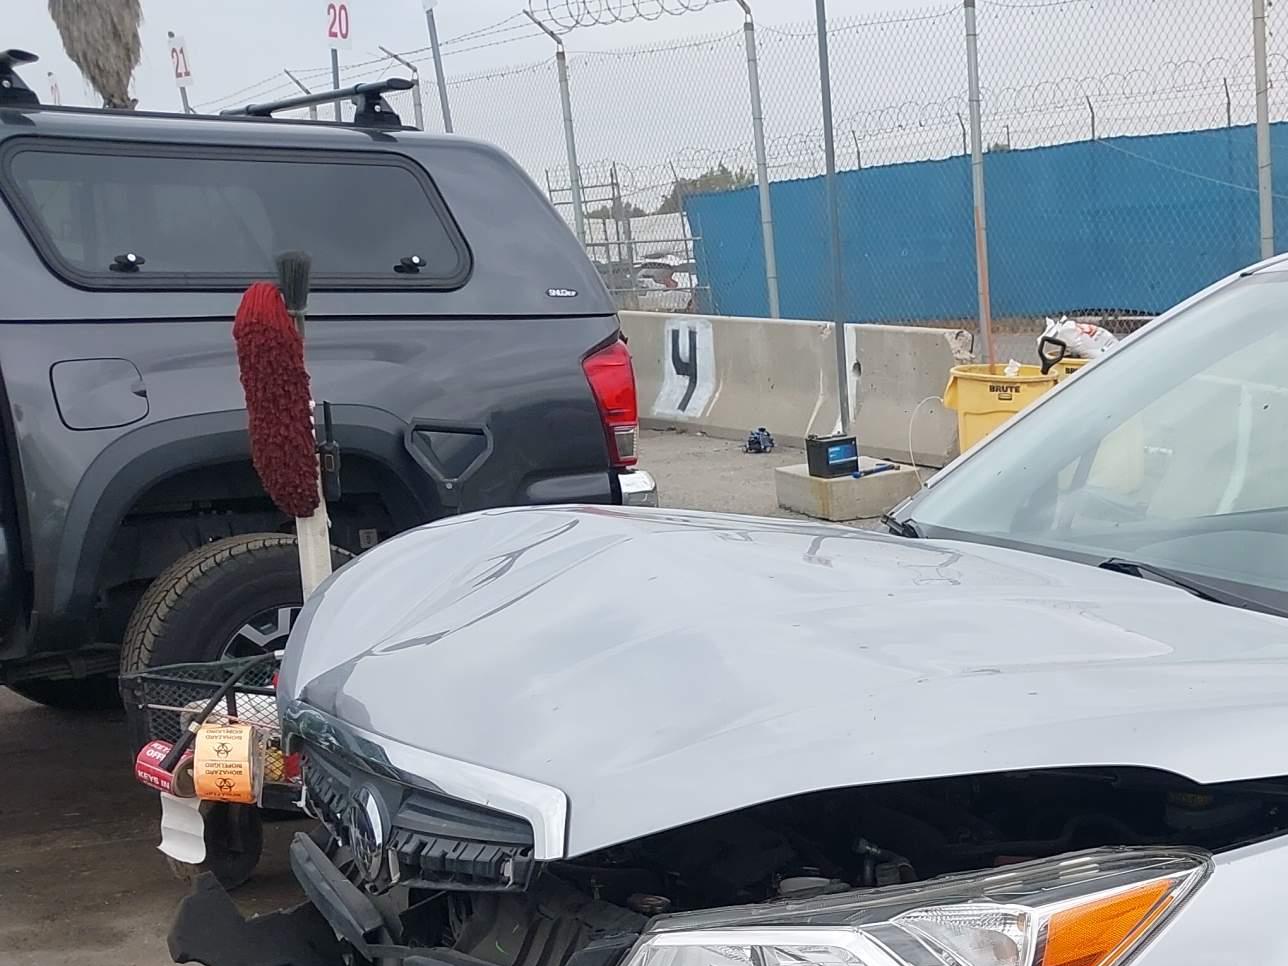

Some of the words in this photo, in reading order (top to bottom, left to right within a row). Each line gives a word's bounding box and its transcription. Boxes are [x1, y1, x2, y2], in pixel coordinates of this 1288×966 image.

[327, 3, 349, 39] 20
[171, 47, 190, 78] 21
[672, 329, 698, 412] 4
[989, 385, 1020, 393] BRUTE
[137, 770, 159, 784] KEYS
[161, 780, 170, 789] IN
